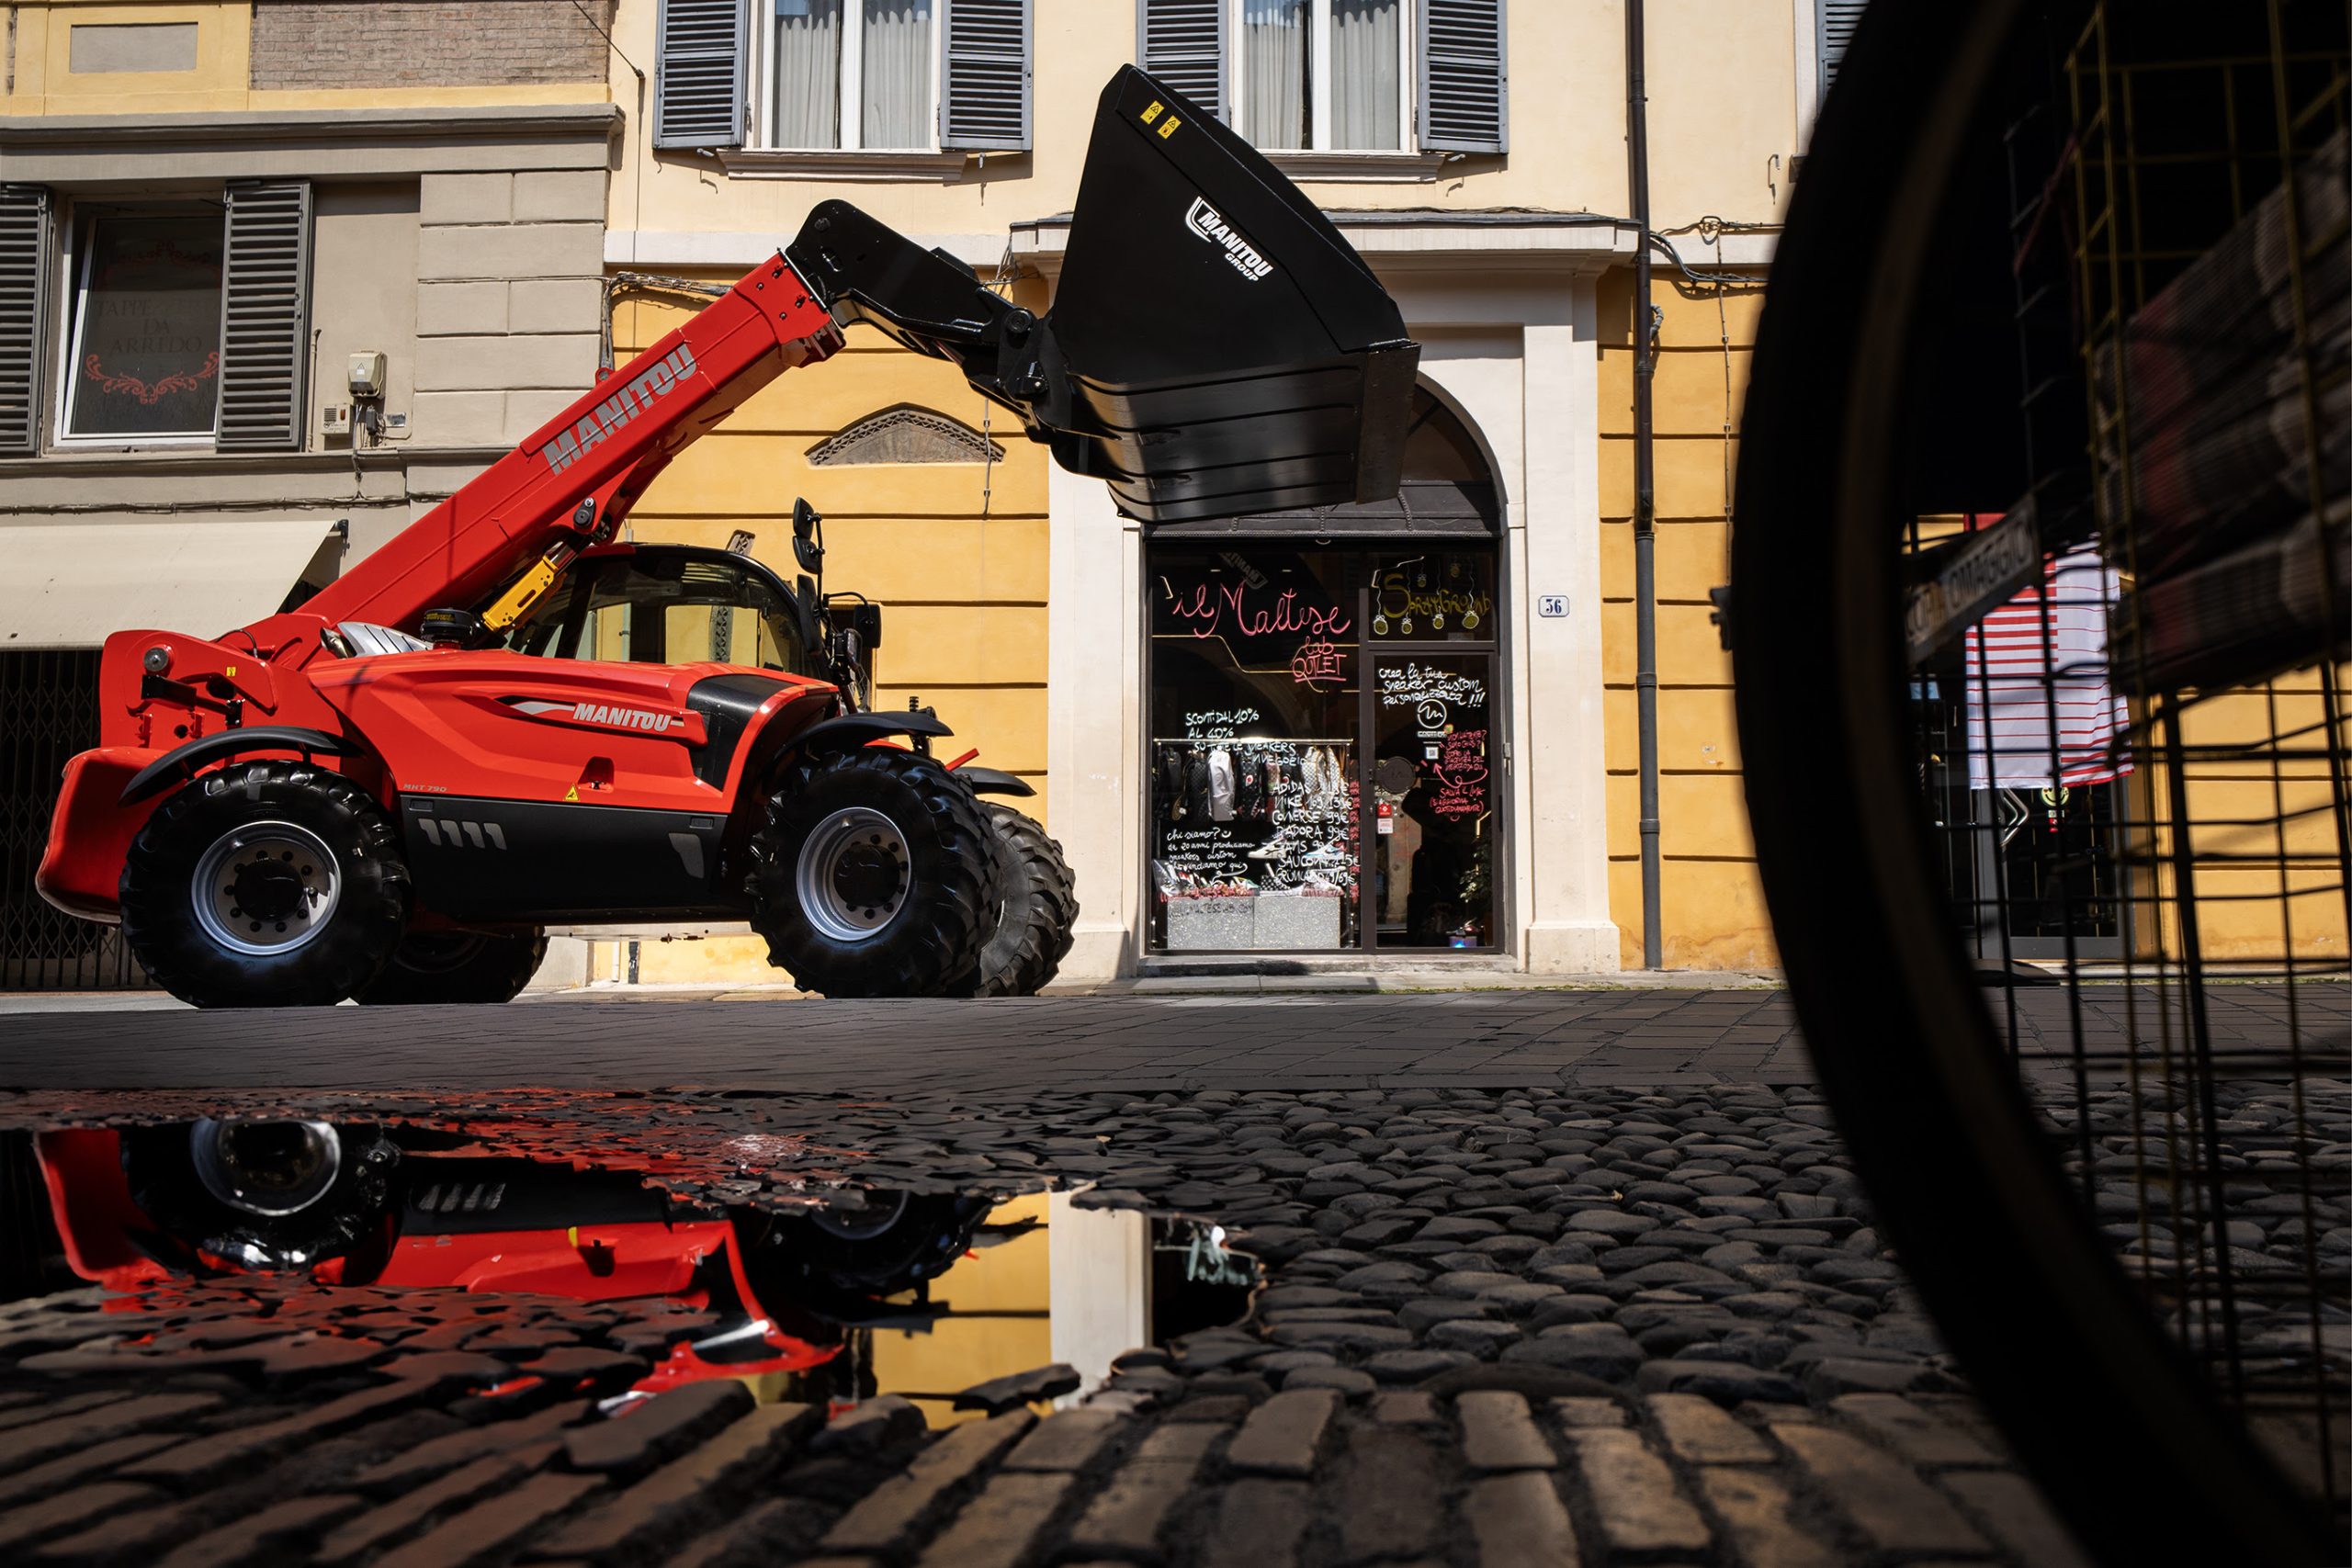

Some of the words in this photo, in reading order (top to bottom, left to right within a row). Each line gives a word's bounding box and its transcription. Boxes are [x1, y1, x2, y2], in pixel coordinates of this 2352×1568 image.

[1197, 211, 1274, 276] MANITOU
[1225, 253, 1259, 281] GROUP
[542, 343, 696, 476] MANITOU
[1172, 583, 1215, 618] il
[1194, 579, 1351, 640] Maltese
[1545, 598, 1562, 615] 36
[1303, 635, 1335, 656] lab
[1292, 654, 1347, 677] OUTLET
[1437, 676, 1483, 694] custom
[572, 703, 672, 732] MANITOU
[1234, 707, 1260, 725] 10%
[1187, 727, 1204, 740] AL
[1206, 727, 1234, 740] 40%
[1273, 792, 1303, 809] NIKE
[1326, 811, 1349, 825] 99€
[1167, 829, 1182, 840] chi
[1184, 827, 1220, 840] siamo?
